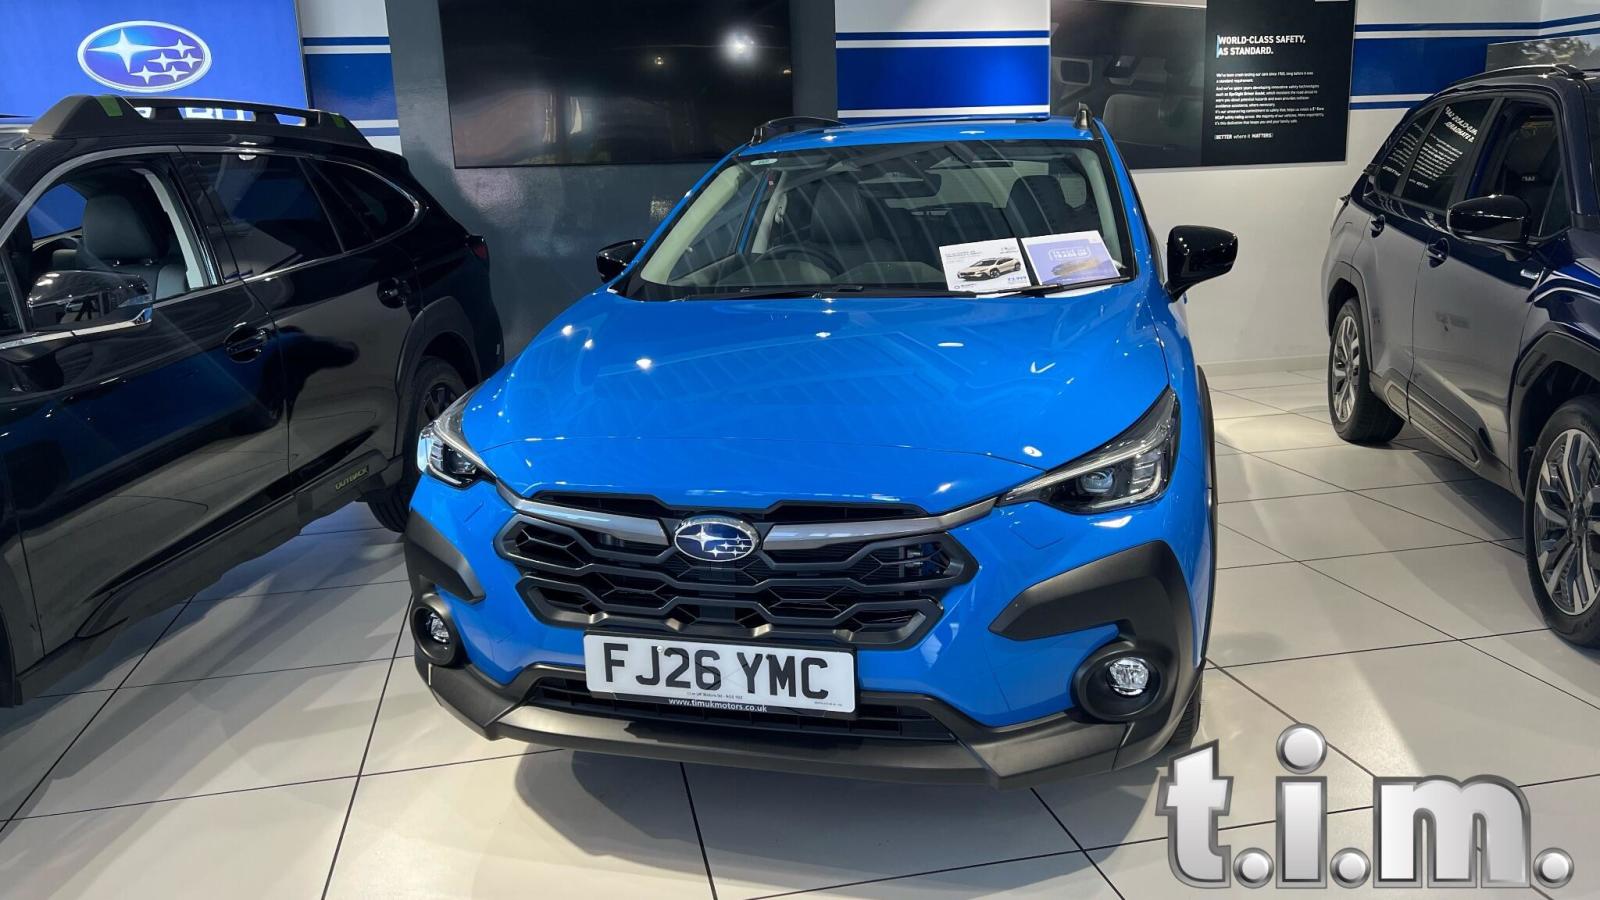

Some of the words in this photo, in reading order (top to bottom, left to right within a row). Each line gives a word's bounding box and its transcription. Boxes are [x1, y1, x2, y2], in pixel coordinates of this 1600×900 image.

[1217, 35, 1274, 45] WORLD-CLASS
[1275, 35, 1306, 44] SAFETY,
[1218, 47, 1229, 56] AS
[1230, 46, 1274, 55] STANDARD.
[603, 642, 722, 691] FJ26
[736, 651, 829, 700] YMC
[668, 699, 768, 713] www.timukmotors.co.uk
